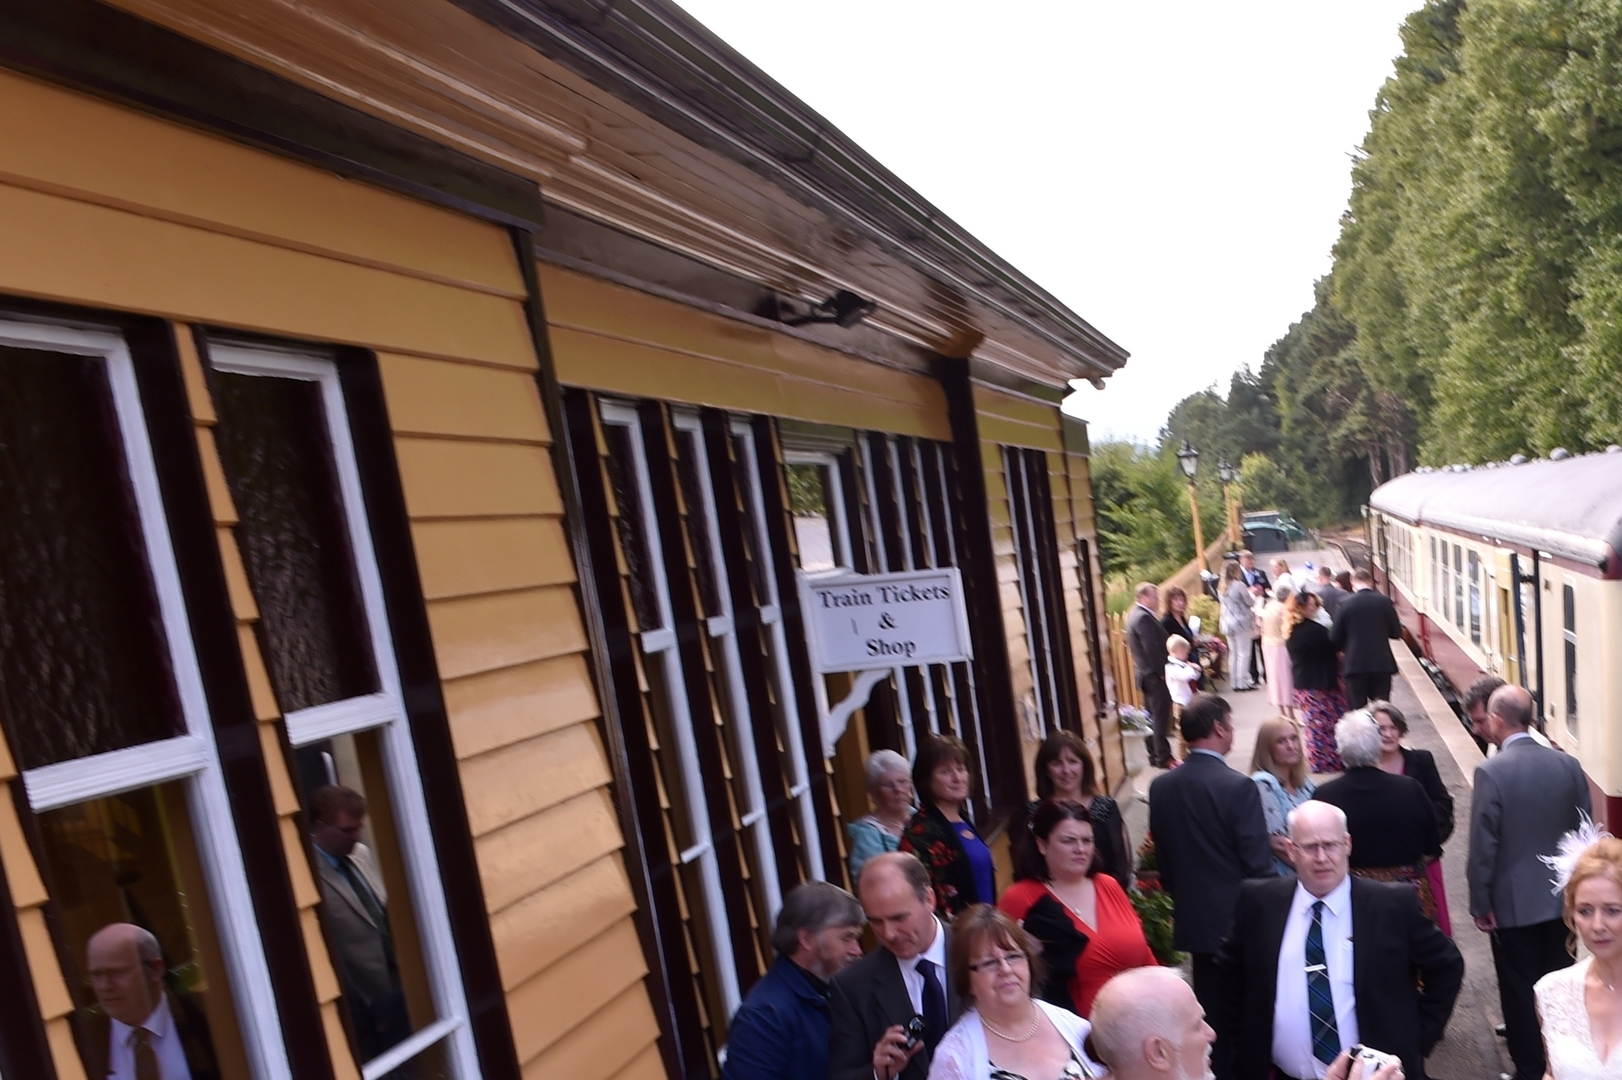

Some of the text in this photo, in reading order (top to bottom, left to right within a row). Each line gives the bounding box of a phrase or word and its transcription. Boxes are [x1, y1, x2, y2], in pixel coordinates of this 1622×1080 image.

[818, 584, 950, 608] Train Tickets
[879, 611, 896, 629] &
[866, 638, 916, 658] Shop
